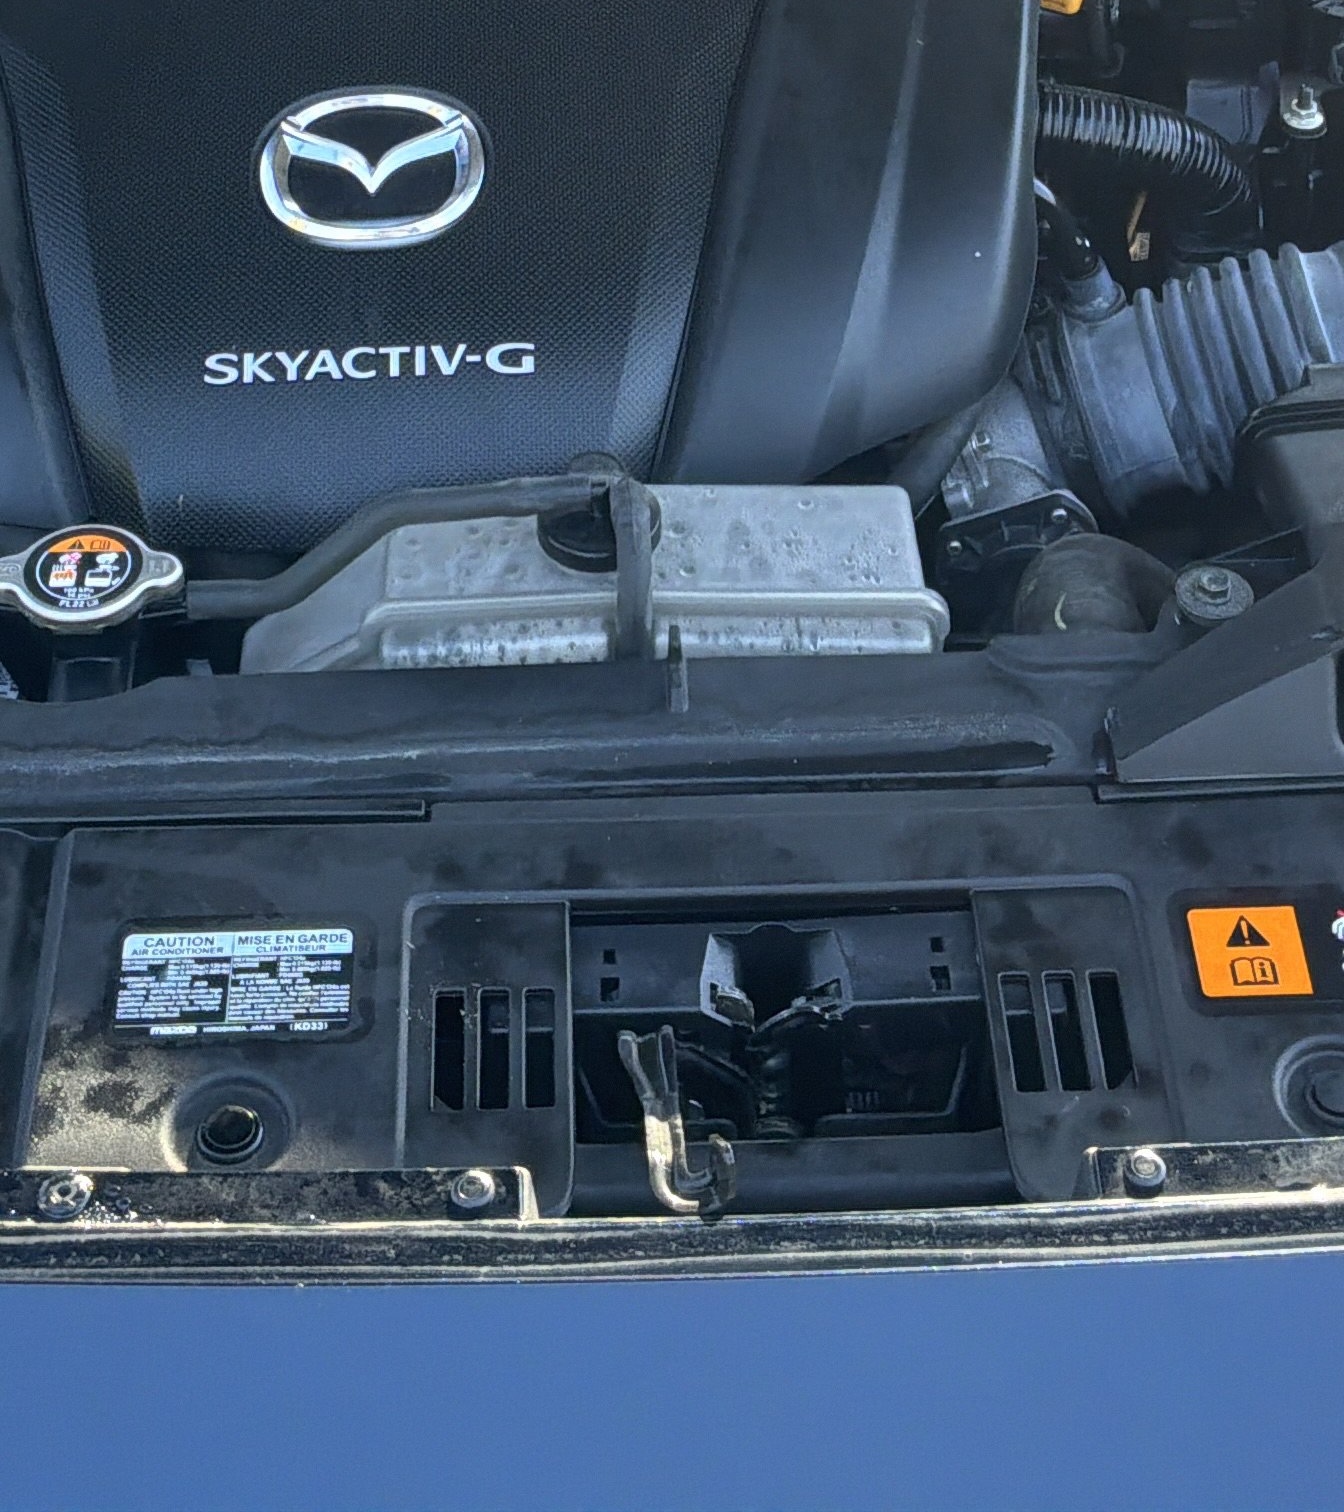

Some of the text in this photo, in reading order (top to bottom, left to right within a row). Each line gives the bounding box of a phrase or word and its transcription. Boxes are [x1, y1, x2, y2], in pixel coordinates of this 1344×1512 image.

[203, 342, 537, 387] SKYACTIV-G
[144, 936, 215, 948] CAUTION
[238, 932, 348, 945] MISE EN GARDE
[131, 946, 225, 956] AIR CONDITIONER
[255, 944, 327, 954] CLIMATISEUR
[290, 1021, 329, 1031] (KD33)
